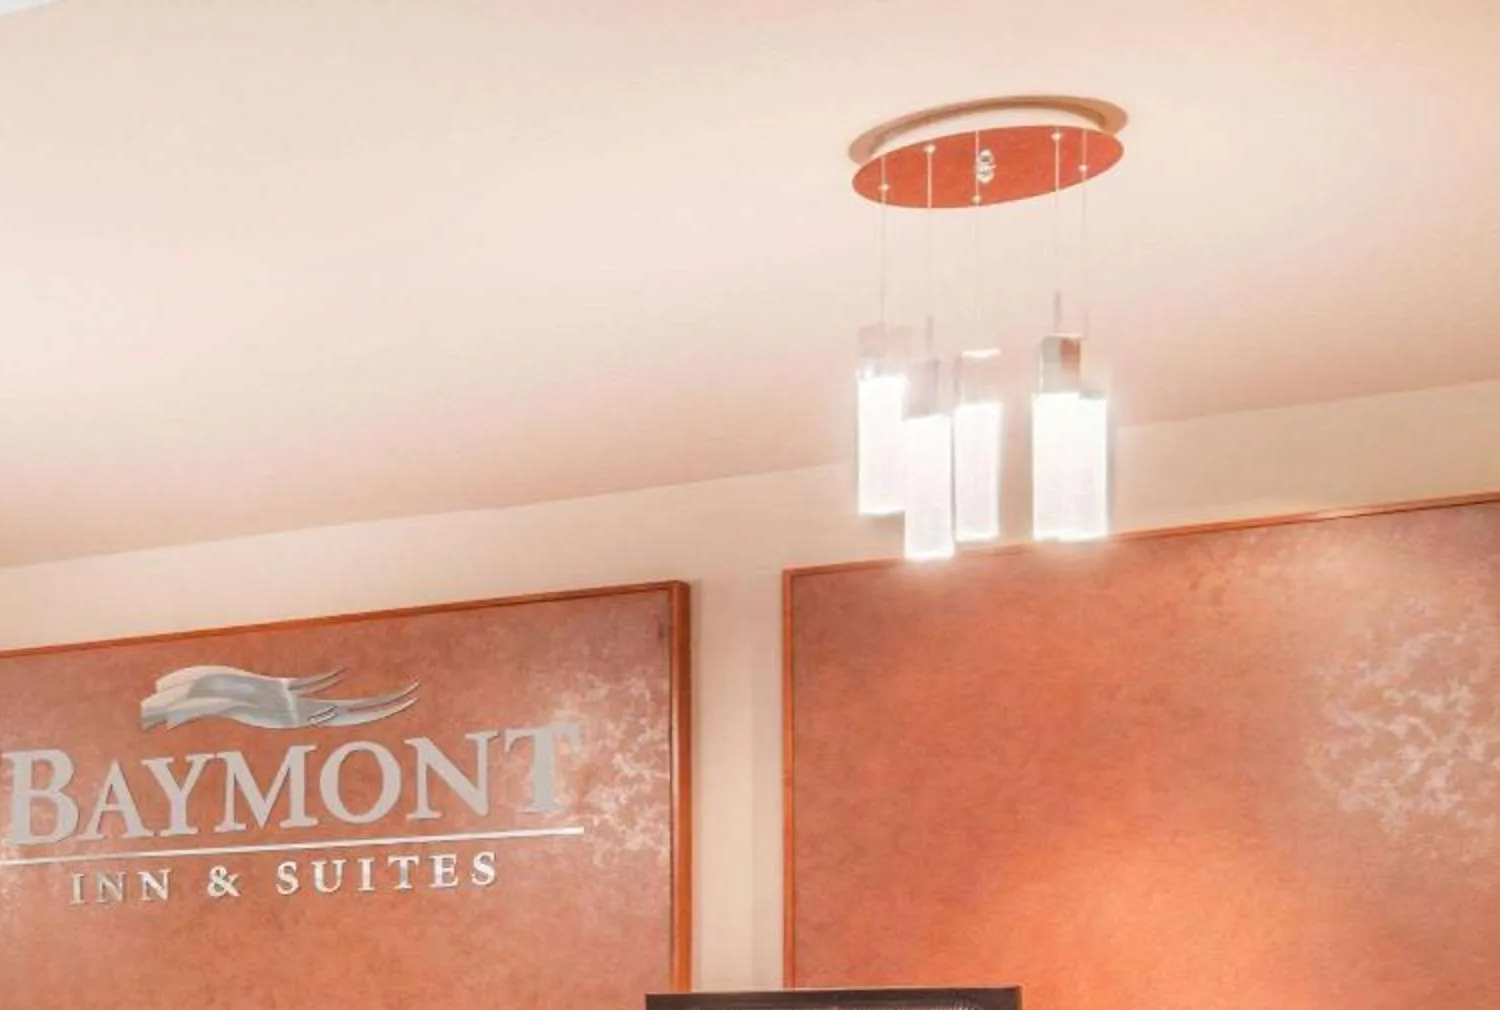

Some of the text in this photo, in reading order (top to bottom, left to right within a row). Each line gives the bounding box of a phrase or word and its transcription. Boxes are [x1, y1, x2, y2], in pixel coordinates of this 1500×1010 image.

[2, 721, 582, 847] BAYMONT
[70, 851, 496, 904] INN & SUITES
